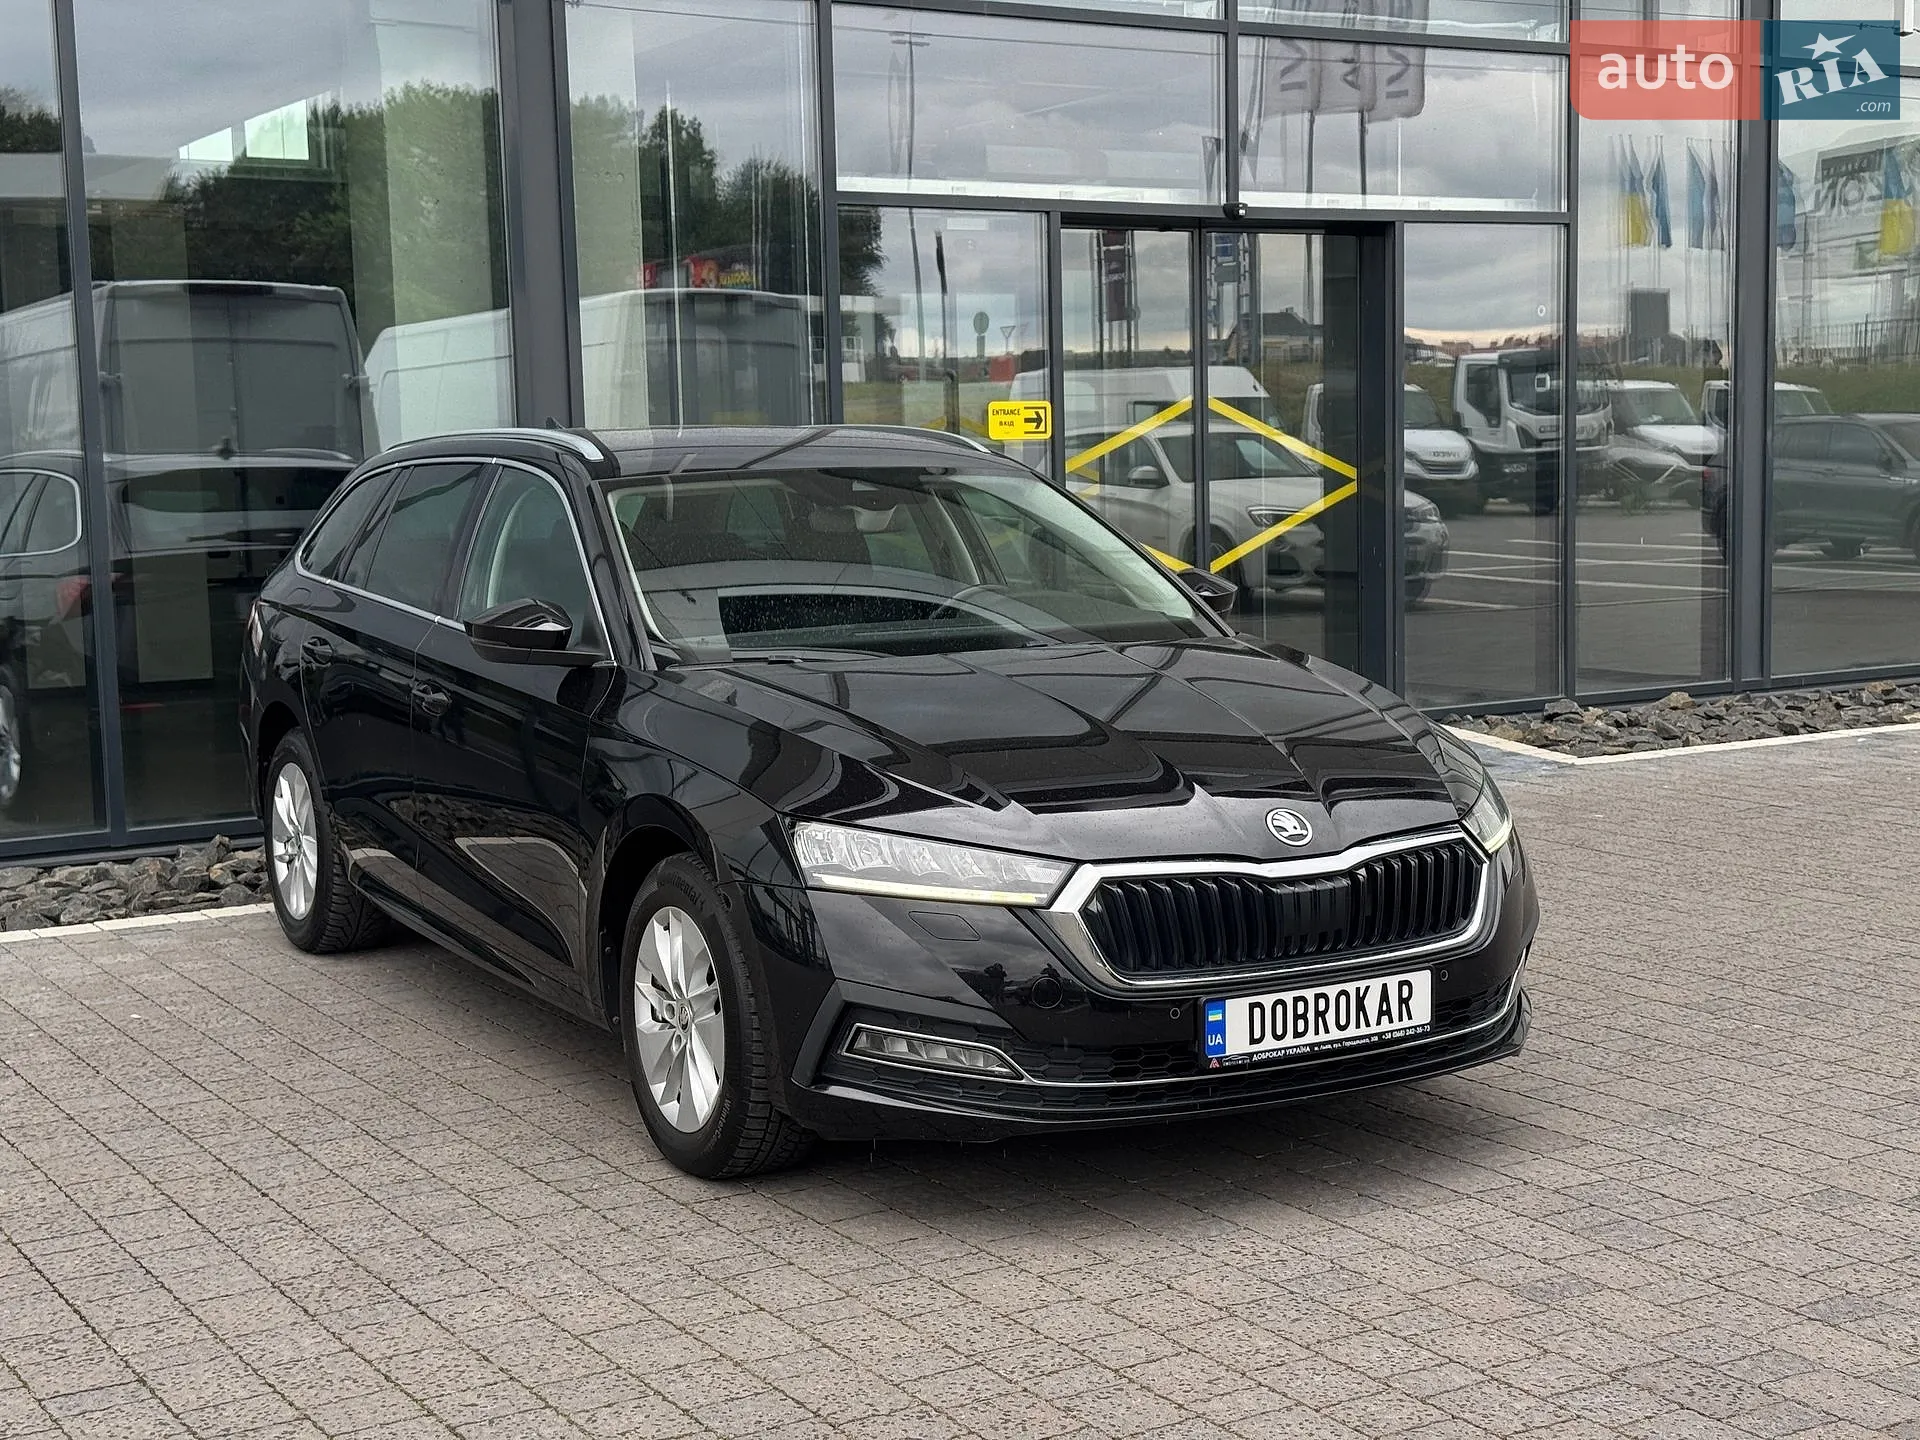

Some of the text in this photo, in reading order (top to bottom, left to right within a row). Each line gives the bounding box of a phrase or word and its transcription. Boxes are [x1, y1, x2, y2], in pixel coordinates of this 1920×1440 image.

[992, 408, 1021, 416] ENTRANCE
[1249, 980, 1413, 1046] DOBROKAR
[1208, 1034, 1223, 1046] UA
[1252, 1049, 1285, 1061] ДОБРОКАР
[1286, 1045, 1311, 1056] УКРАЇНА
